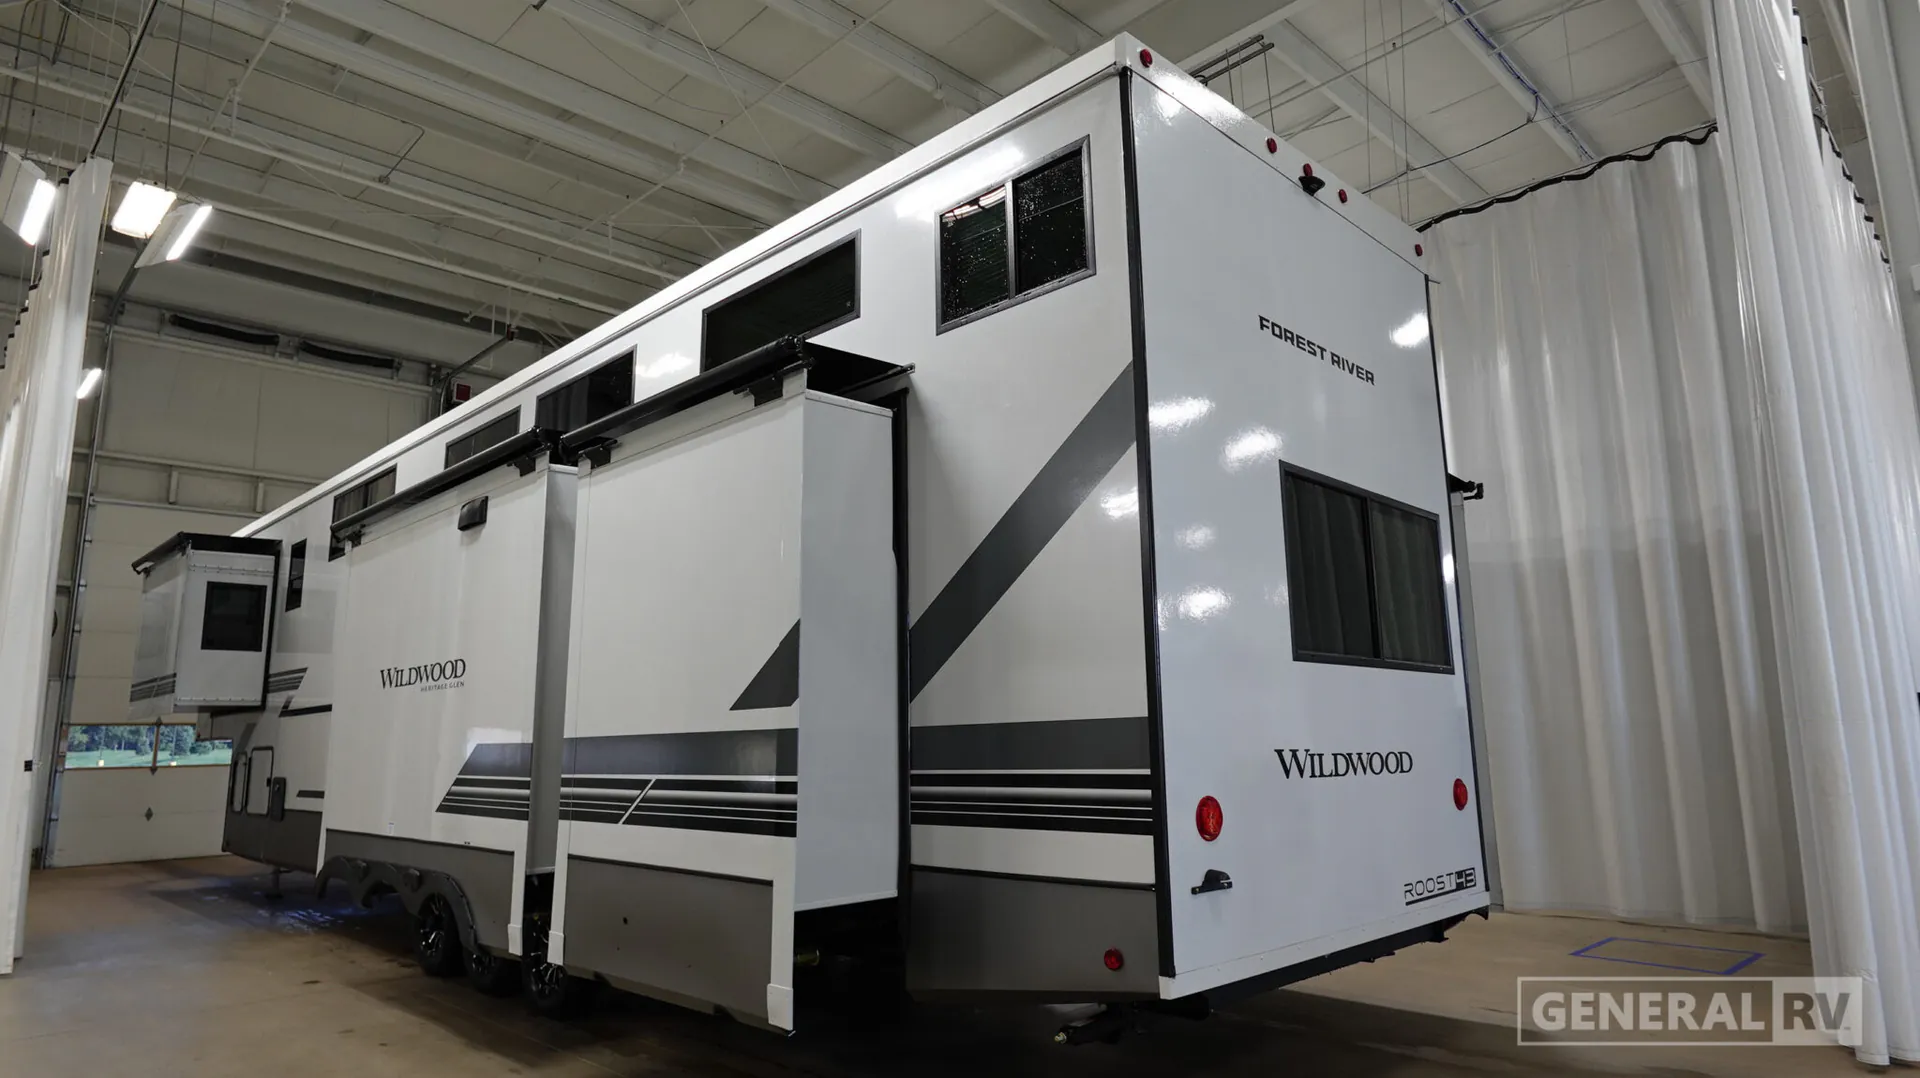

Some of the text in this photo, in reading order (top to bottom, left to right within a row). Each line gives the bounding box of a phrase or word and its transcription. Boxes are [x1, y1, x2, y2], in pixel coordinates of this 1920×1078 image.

[1258, 315, 1375, 386] FOREST RIVER
[380, 658, 466, 690] WILDWOOD
[420, 681, 465, 692] HERITAGE GLEN
[1274, 748, 1413, 779] WILDWOOD
